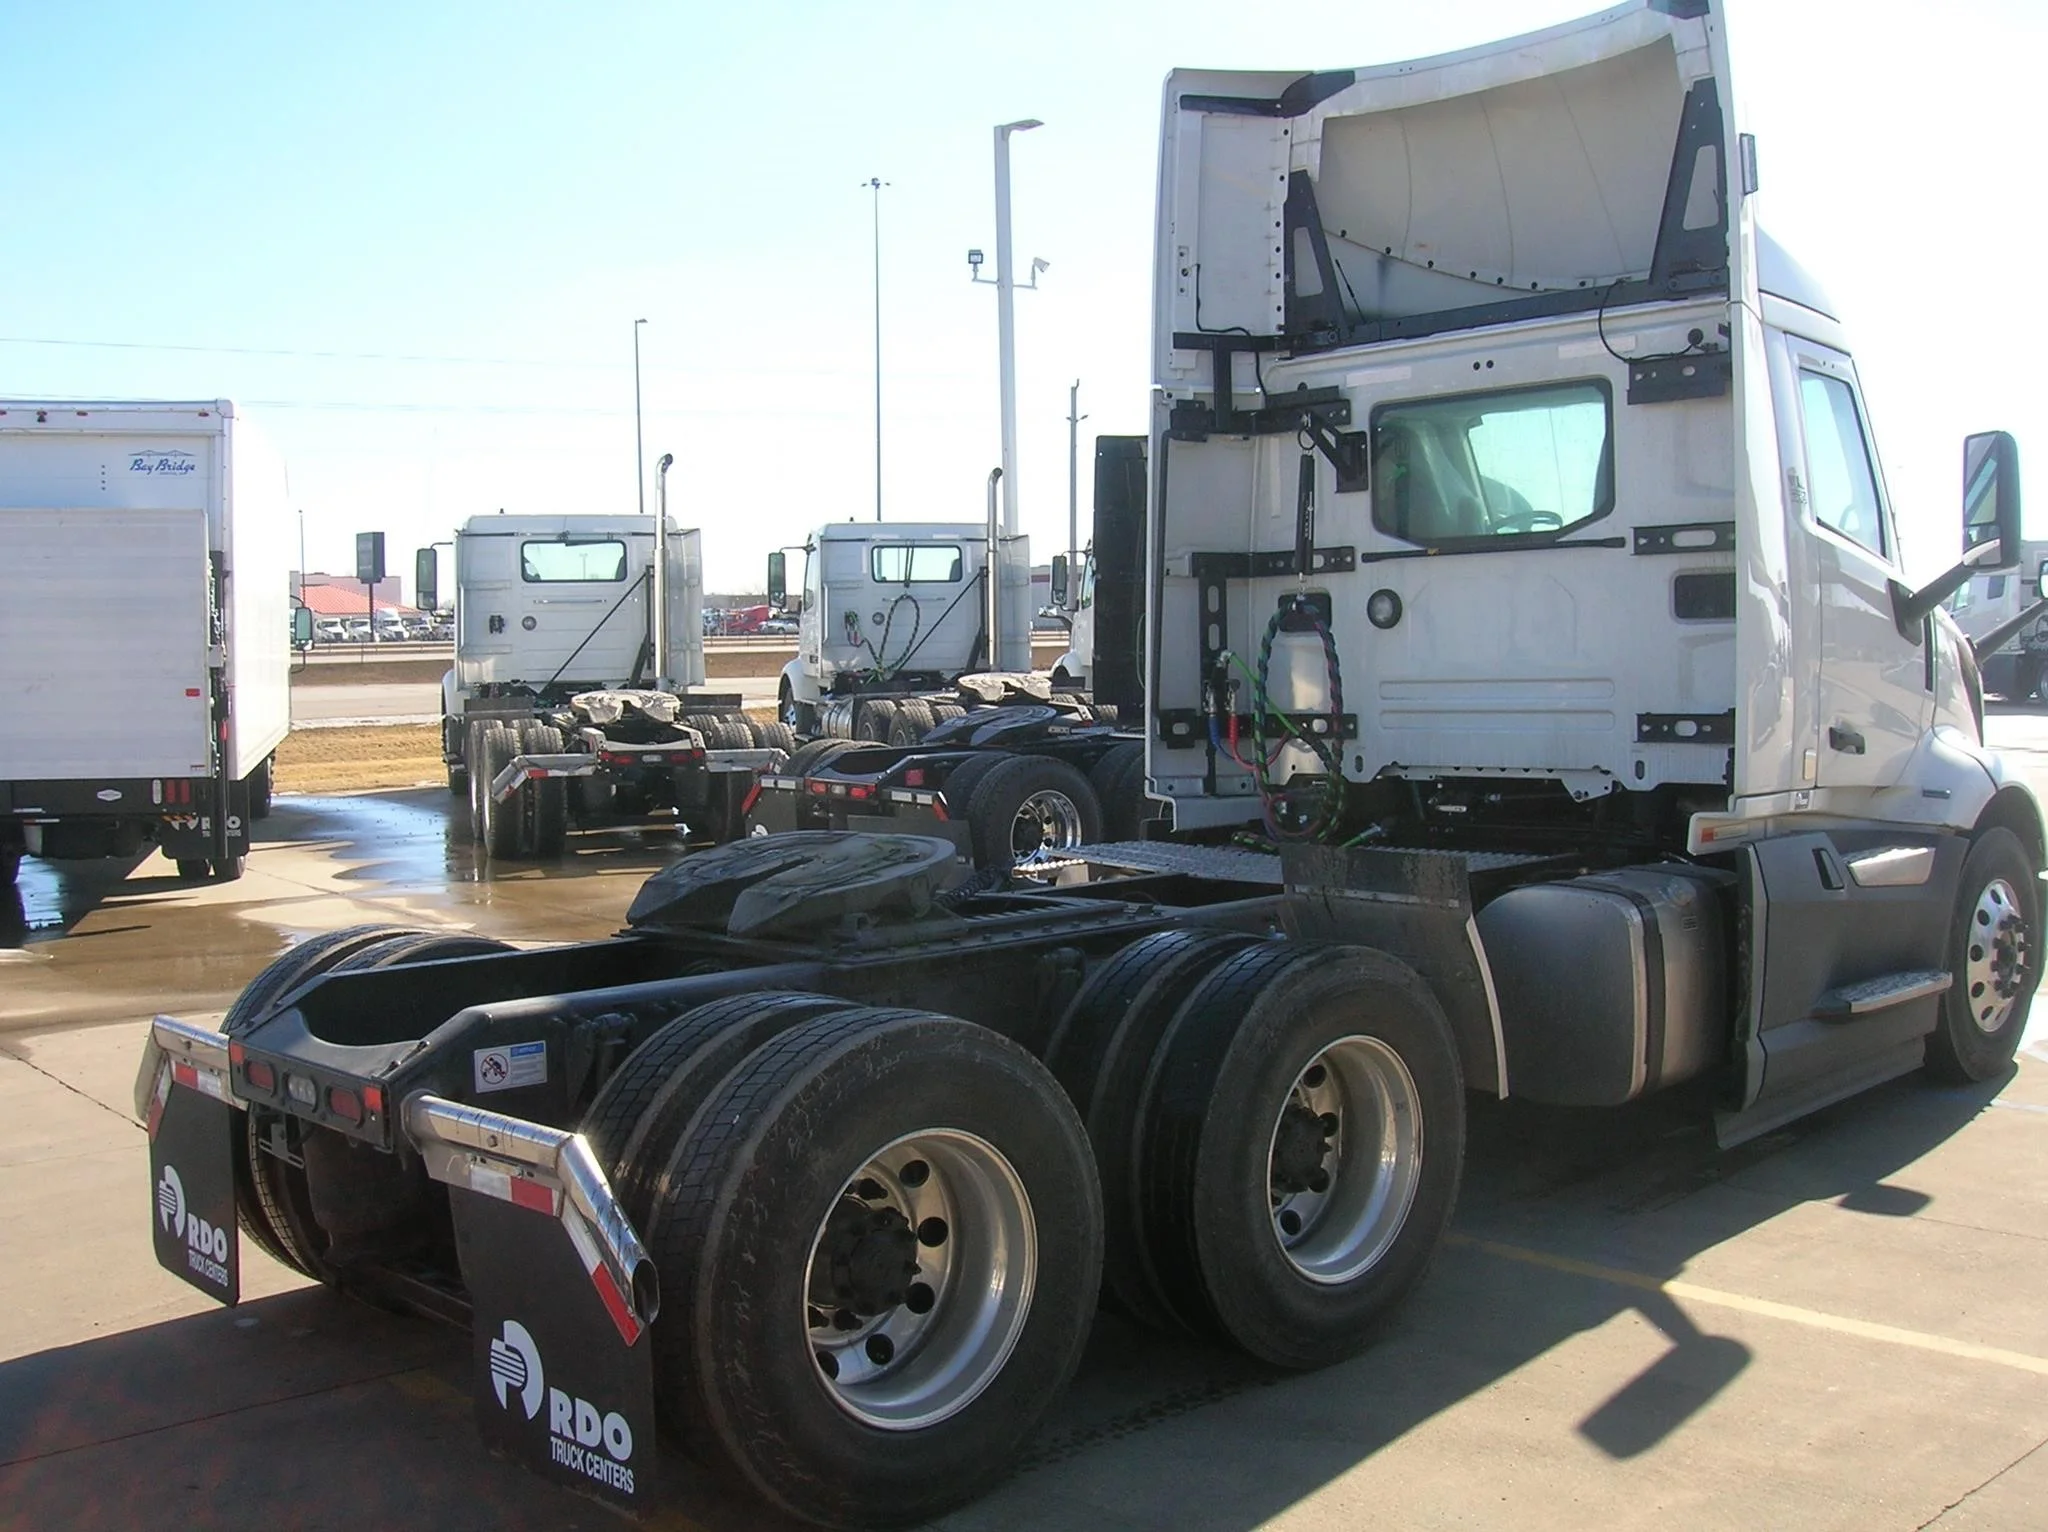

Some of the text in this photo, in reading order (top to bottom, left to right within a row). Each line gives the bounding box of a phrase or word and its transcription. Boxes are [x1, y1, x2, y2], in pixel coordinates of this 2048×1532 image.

[129, 458, 195, 475] Bay Bridge
[187, 1213, 228, 1263] RDO
[550, 1386, 633, 1461] RDO
[550, 1436, 635, 1494] TRUCK CENTERS
